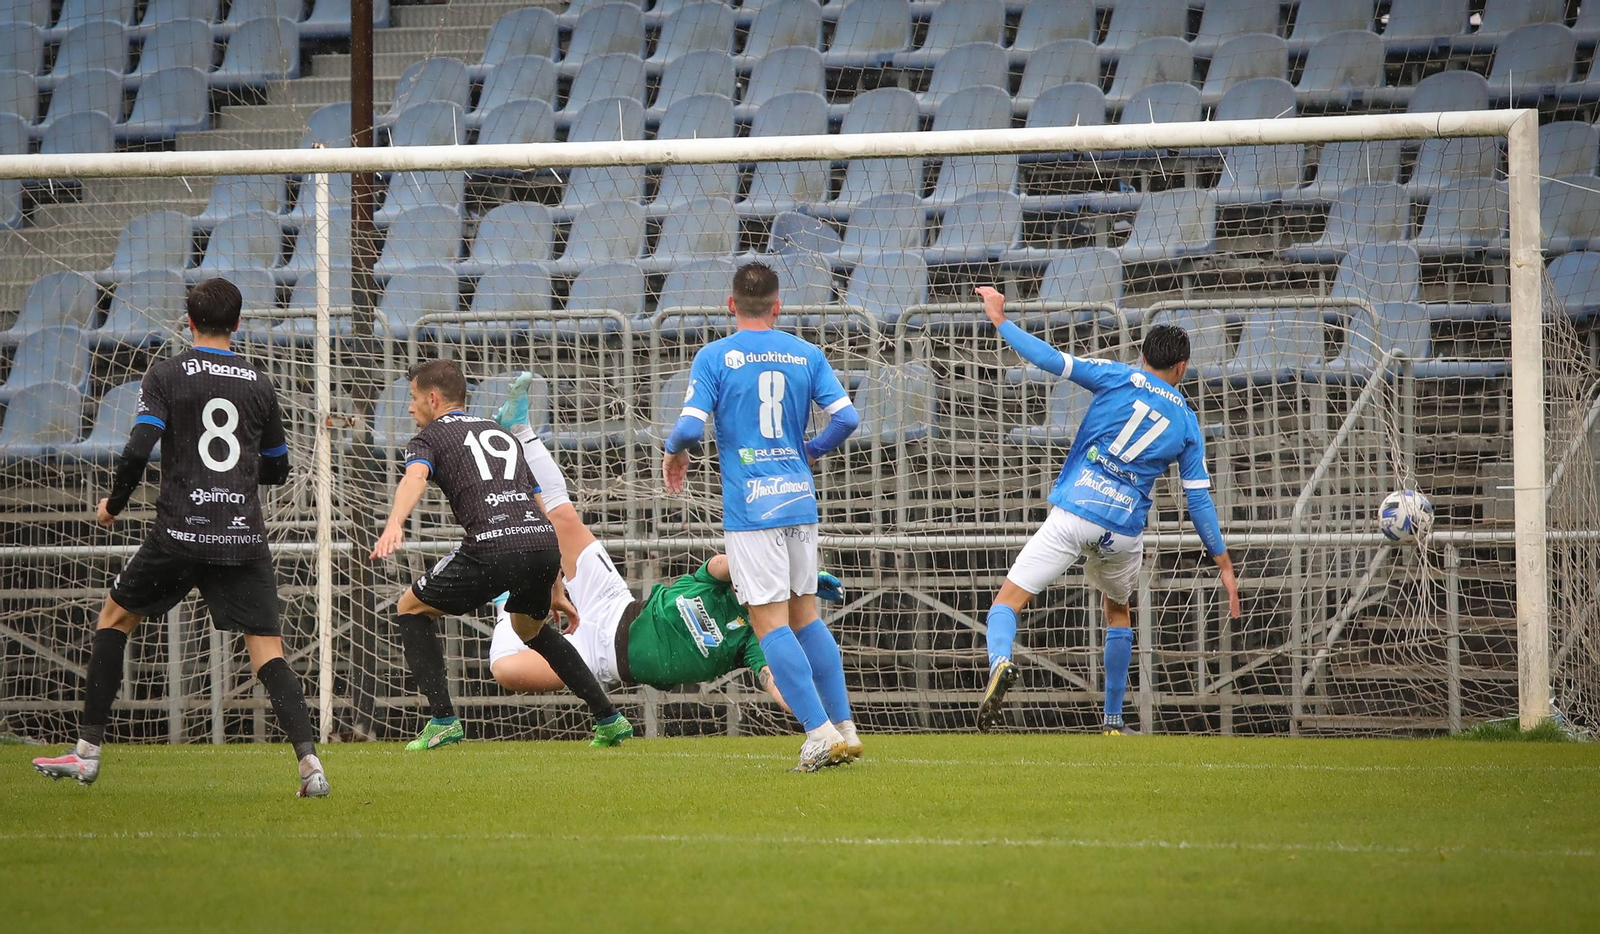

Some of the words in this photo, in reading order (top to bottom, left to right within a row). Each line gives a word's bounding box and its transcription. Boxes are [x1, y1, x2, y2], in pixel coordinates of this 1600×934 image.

[746, 351, 807, 366] duokitchen
[758, 370, 785, 439] 8
[198, 397, 241, 473] 8
[463, 429, 519, 481] 19
[1108, 399, 1171, 464] 17
[198, 533, 251, 545] DEPORTIVO
[475, 529, 504, 542] XEREZ
[504, 524, 546, 535] DEPORTIVO
